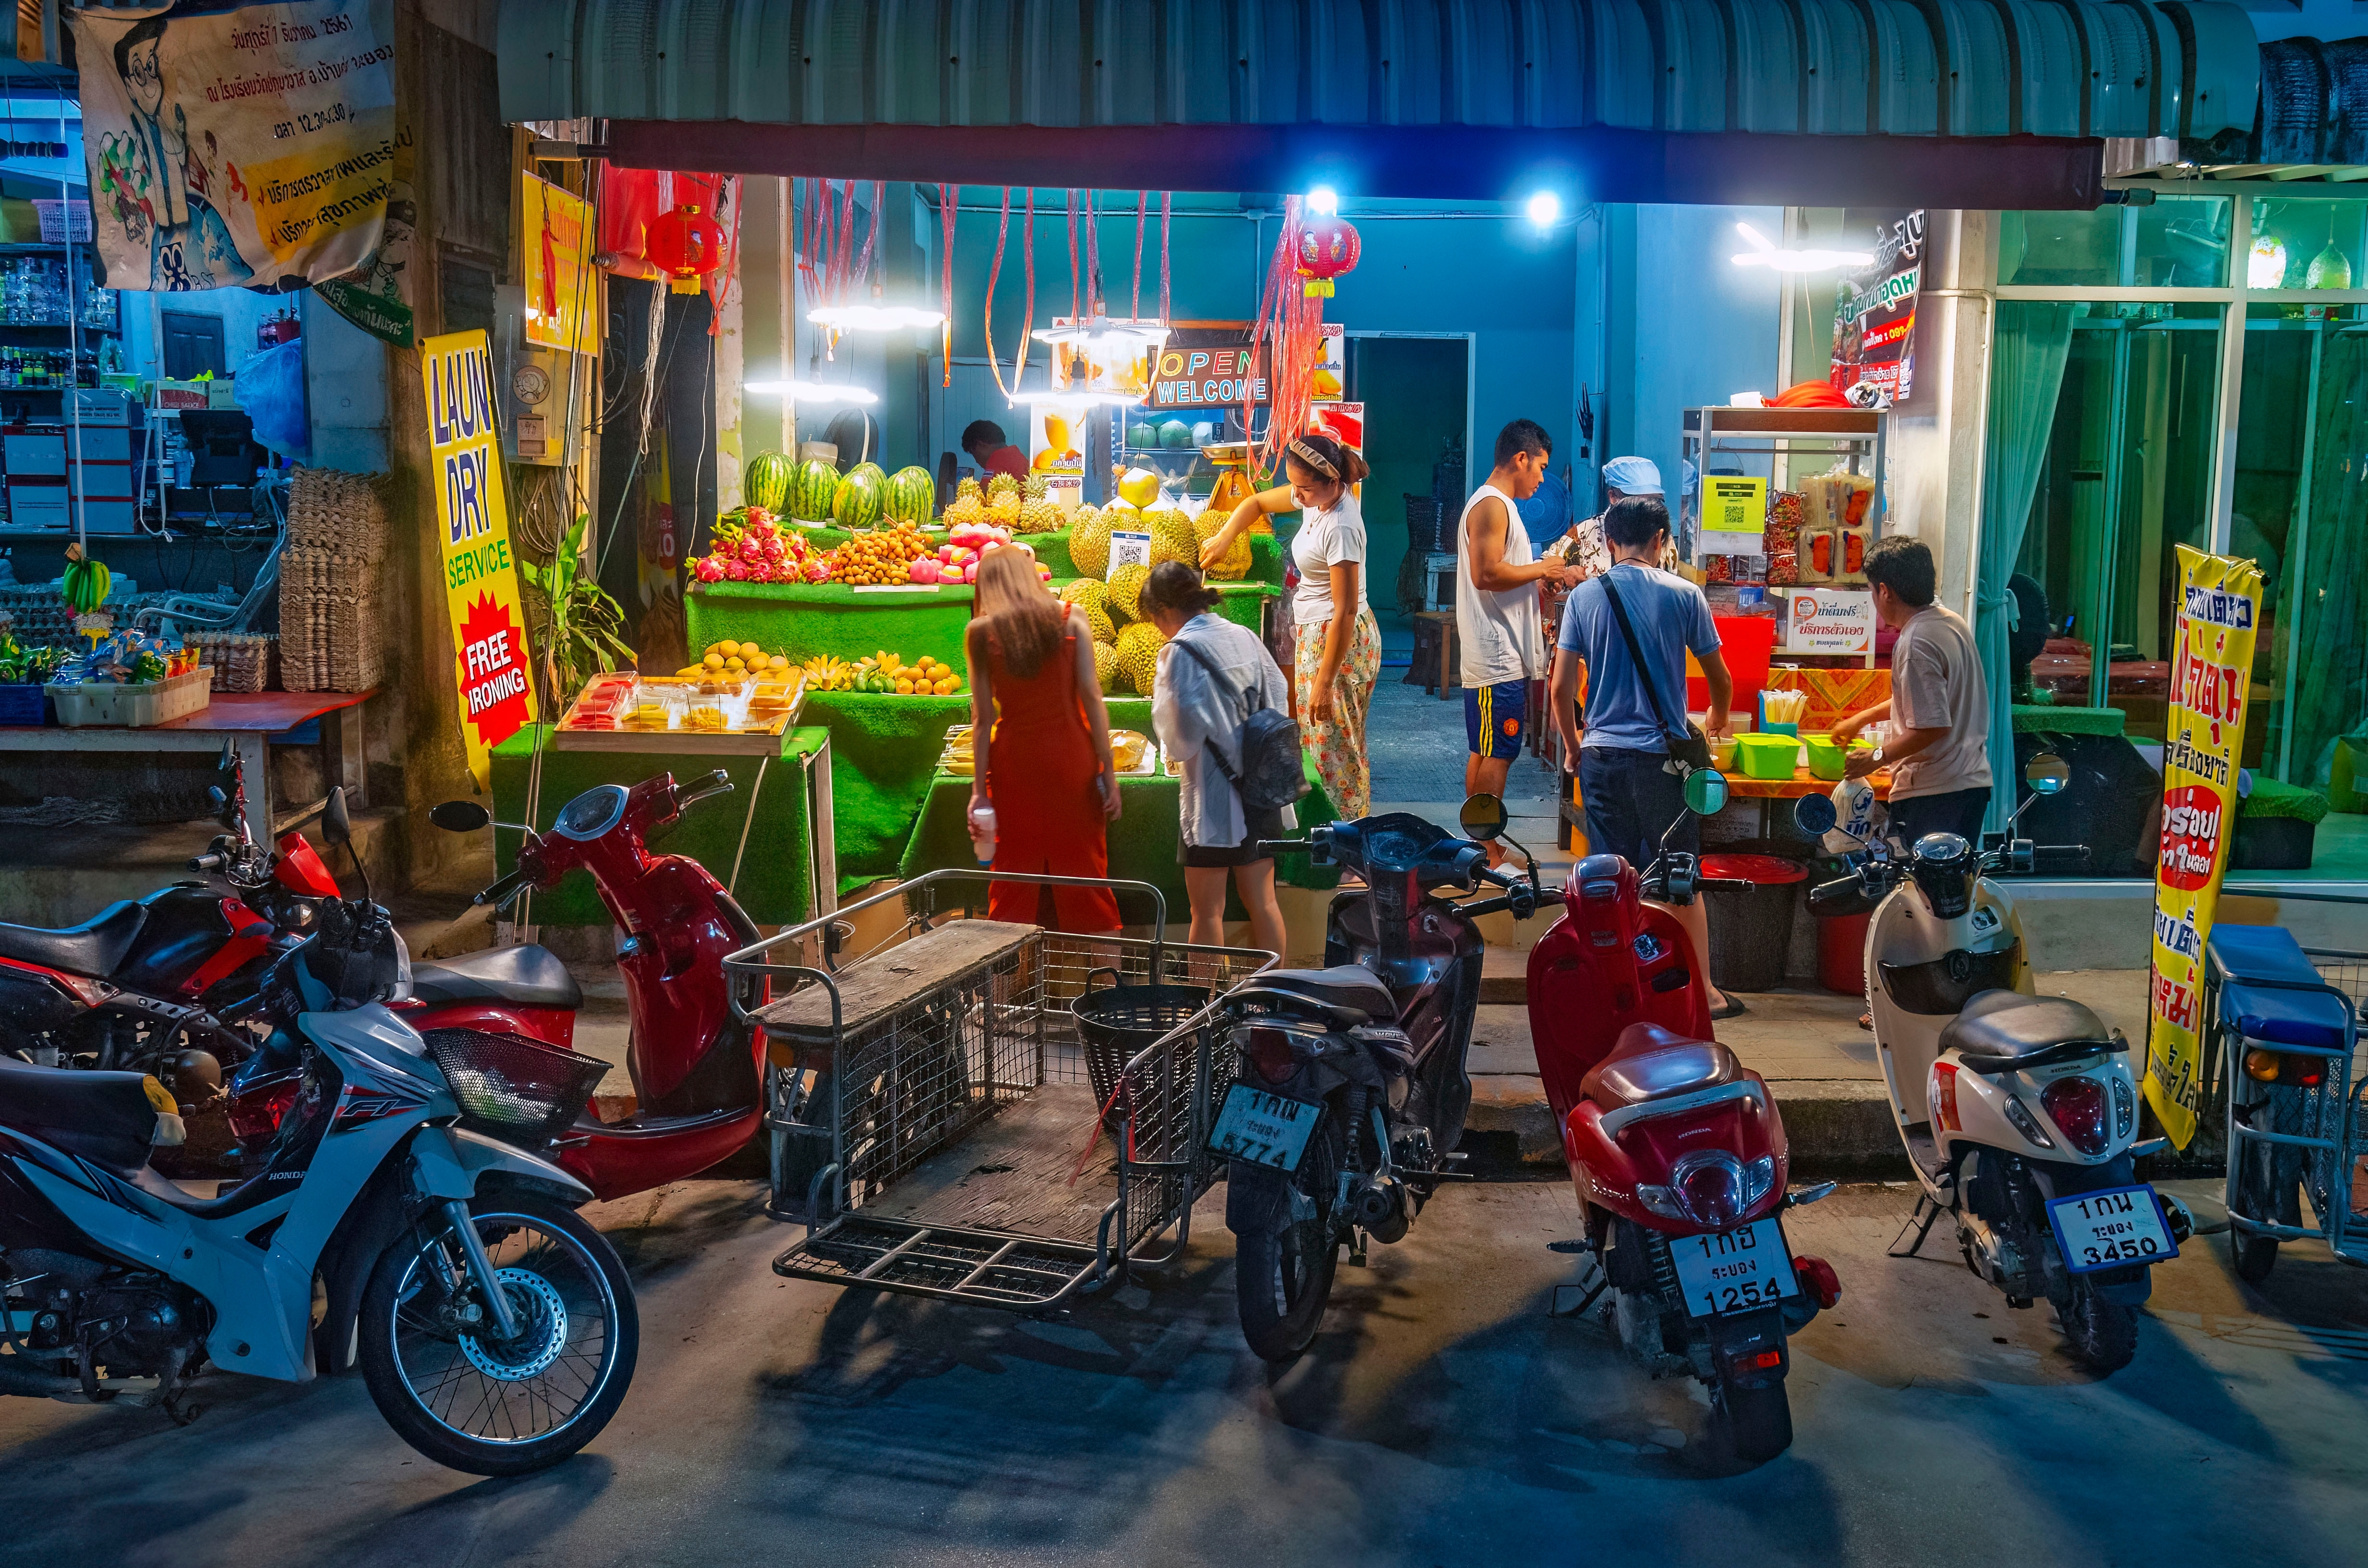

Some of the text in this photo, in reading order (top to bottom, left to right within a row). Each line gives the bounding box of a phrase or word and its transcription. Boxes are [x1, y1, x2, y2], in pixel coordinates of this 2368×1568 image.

[320, 13, 353, 35] 2561
[1160, 351, 1252, 377] OPEN
[431, 346, 492, 446] LAUN
[1157, 379, 1267, 404] WELCOME
[1330, 404, 1362, 413] 西瓜冰沙
[446, 447, 491, 544] DRY
[449, 539, 510, 589] SERVICE
[1818, 601, 1857, 616] น้ำดื่มฟรี
[1800, 623, 1864, 635] บริการตัวเอง
[466, 632, 512, 681] FREE
[469, 668, 525, 716] IRONING
[2051, 1065, 2082, 1073] HONDA
[1678, 1128, 1712, 1139] HONDA
[2092, 1221, 2134, 1238] ระยอง
[2084, 1237, 2158, 1265] 3450
[1712, 1260, 1756, 1280] ระยอง
[1704, 1277, 1781, 1313] 1254
